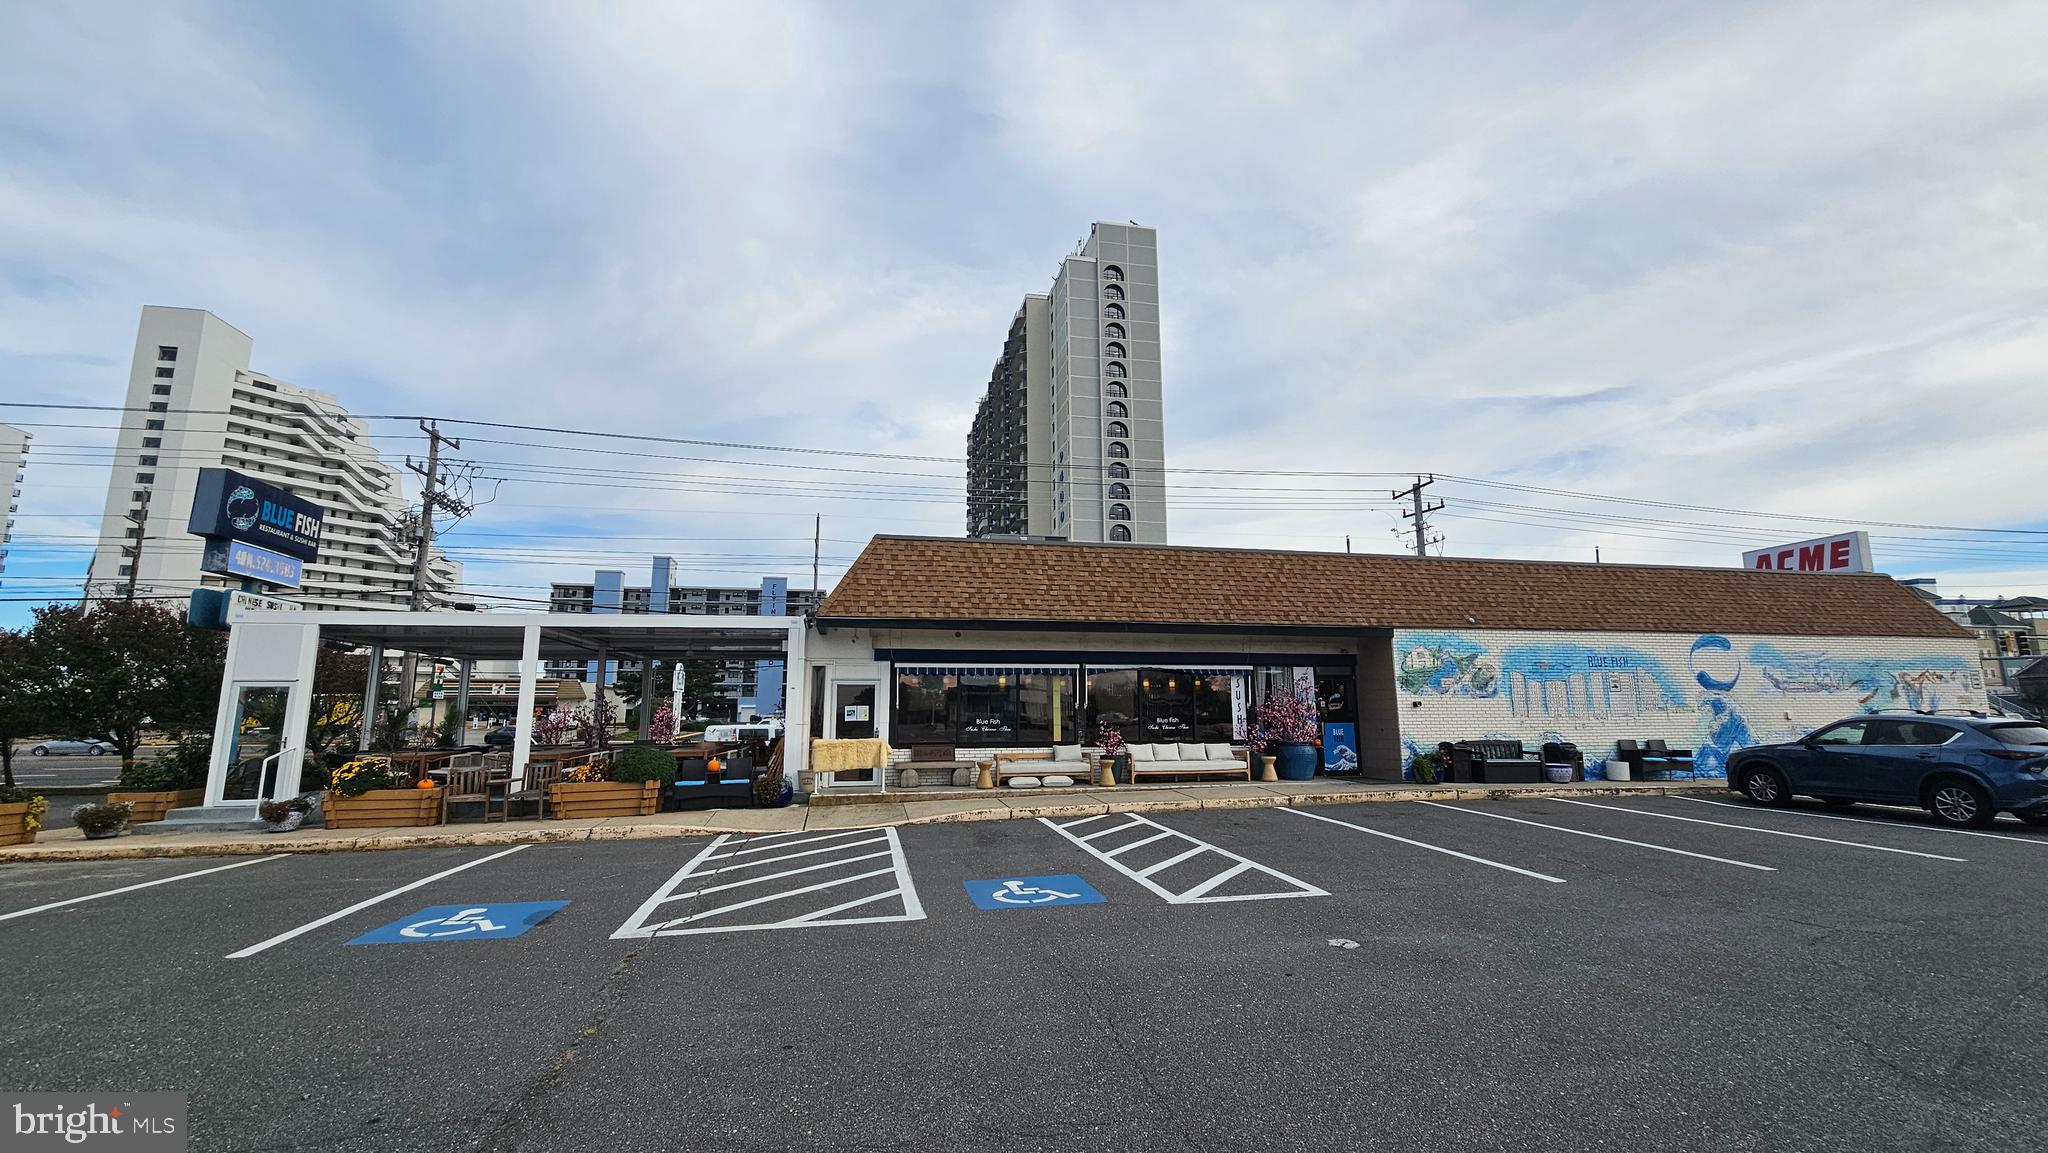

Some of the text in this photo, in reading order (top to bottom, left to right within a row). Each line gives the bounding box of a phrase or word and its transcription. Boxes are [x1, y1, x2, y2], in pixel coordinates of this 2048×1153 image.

[261, 501, 320, 539] BLUE FISH
[259, 524, 290, 539] RESTAURANT
[294, 535, 308, 544] SUSHI
[308, 540, 317, 548] BAR
[1755, 539, 1850, 572] ACME
[1587, 656, 1629, 667] BLUE FISH
[1235, 678, 1243, 733] SUSH
[1332, 728, 1344, 736] BLUE
